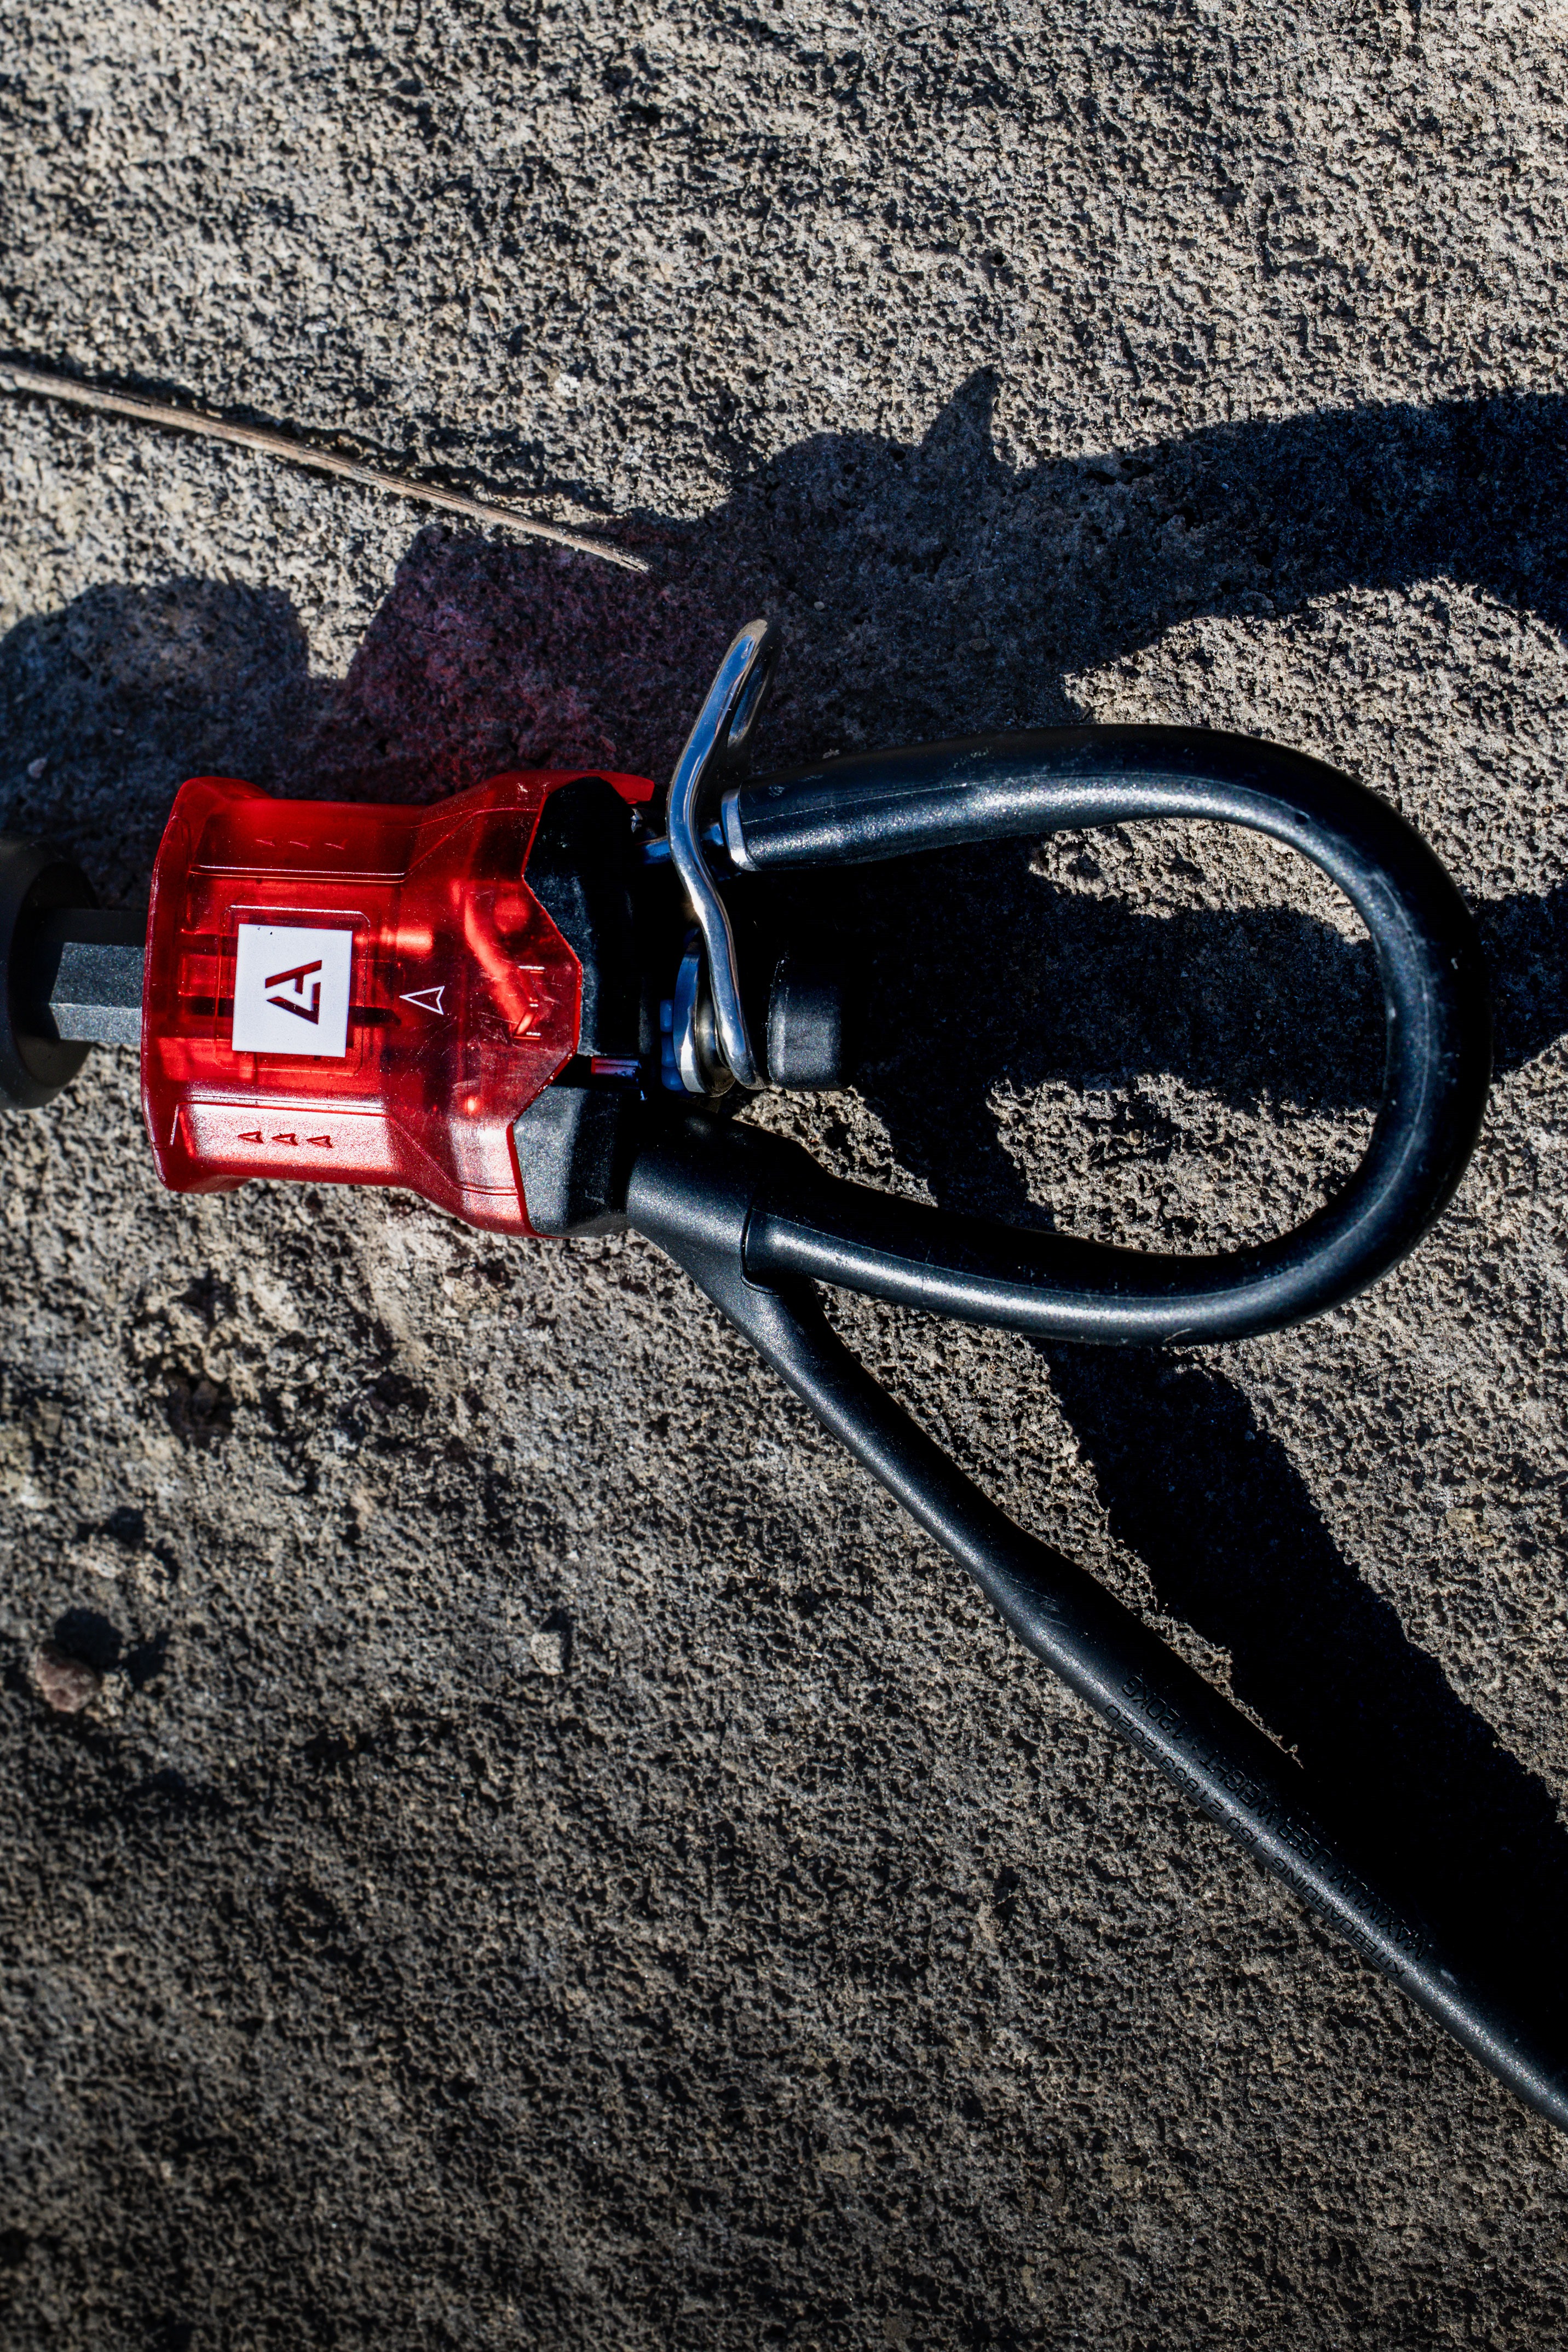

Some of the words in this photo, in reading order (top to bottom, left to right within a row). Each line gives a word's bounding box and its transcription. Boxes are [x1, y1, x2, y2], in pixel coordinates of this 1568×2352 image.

[1122, 1674, 1187, 1740] 120KG
[1105, 1704, 1225, 1815] 21853:2020
[1199, 1750, 1279, 1825] WEIGHT
[1226, 1817, 1258, 1848] ISO
[1277, 1818, 1333, 1872] USER
[1272, 1857, 1405, 1979] KITEBOARDING
[1329, 1865, 1432, 1960] MAXIMUM
